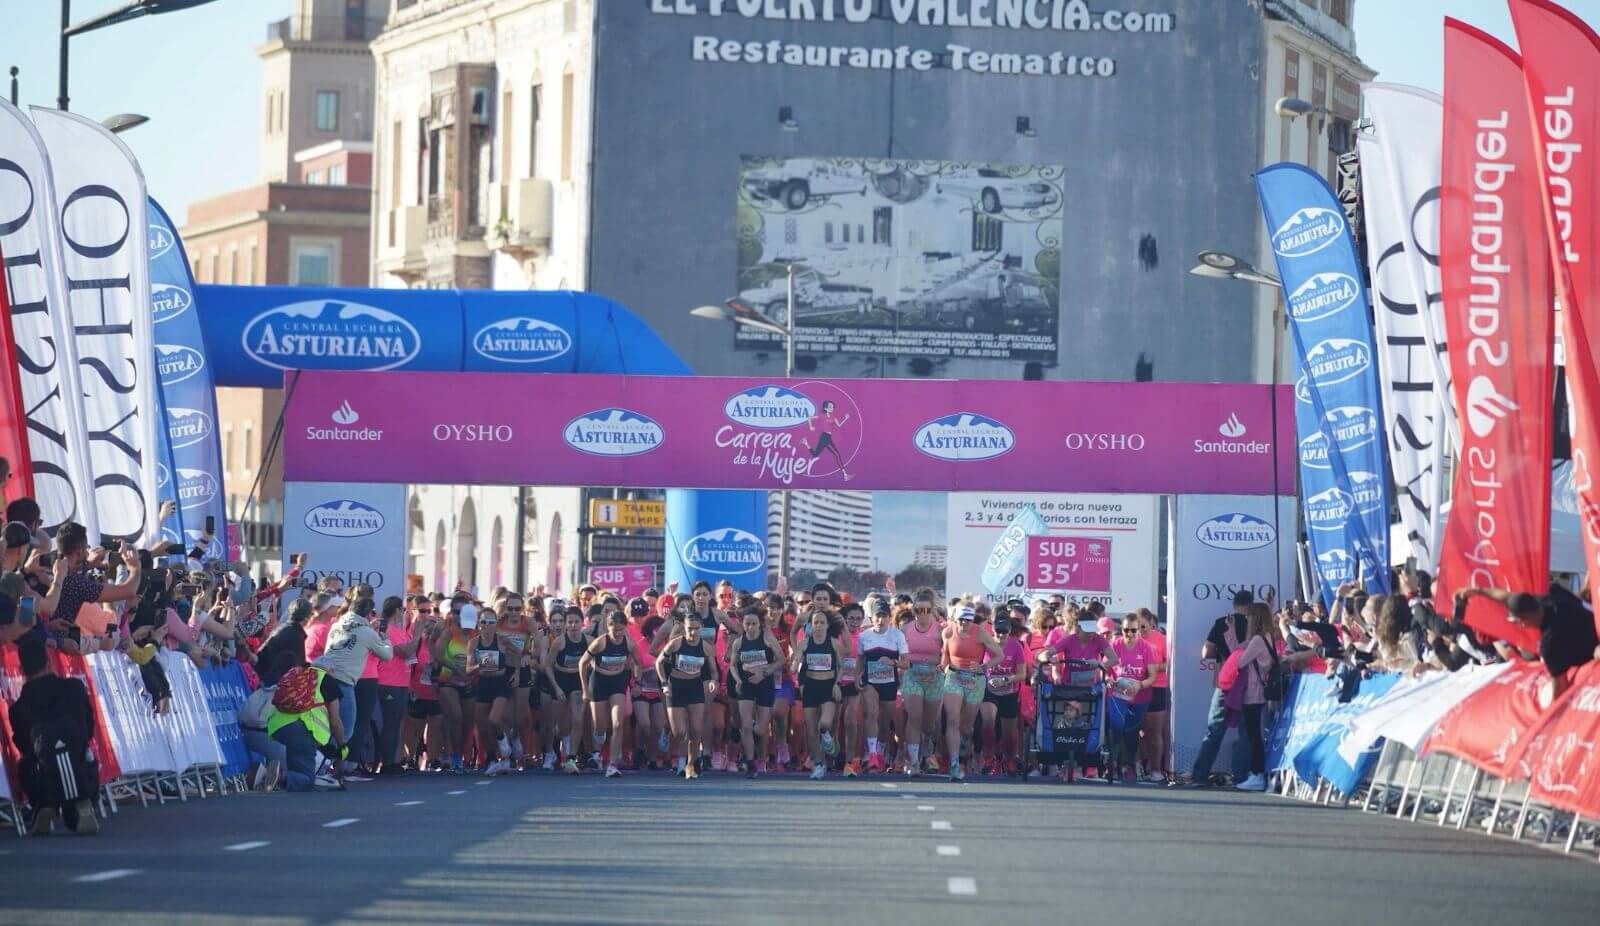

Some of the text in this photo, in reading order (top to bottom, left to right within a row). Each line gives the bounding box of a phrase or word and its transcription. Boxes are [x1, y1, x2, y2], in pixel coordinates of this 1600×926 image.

[693, 36, 1113, 77] Restaurante Tematico
[255, 323, 406, 357] ASTURIANA
[481, 334, 564, 351] ASTURIANA
[732, 400, 809, 418] ASTURIANA
[306, 427, 384, 441] Santander
[433, 424, 513, 442] OYSHO
[572, 425, 656, 445] ASTURIANA
[715, 425, 792, 448] Carrera
[922, 430, 1007, 449] ASTURIANA
[1065, 433, 1145, 451] OYSHO
[1194, 439, 1270, 454] Santander
[733, 448, 820, 484] de la Mujer
[1040, 500, 1054, 511] de
[1058, 501, 1084, 512] obra
[1088, 503, 1122, 513] nueva
[310, 512, 378, 529] ASTURIANA
[997, 513, 1004, 522] 4
[1074, 514, 1096, 525] con
[1100, 515, 1138, 525] terraza
[1202, 526, 1270, 542] ASTURIANA
[690, 543, 760, 563] ASTURIANA
[1040, 542, 1076, 557] SUB
[301, 569, 384, 589] OSHO
[593, 571, 624, 583] SUB
